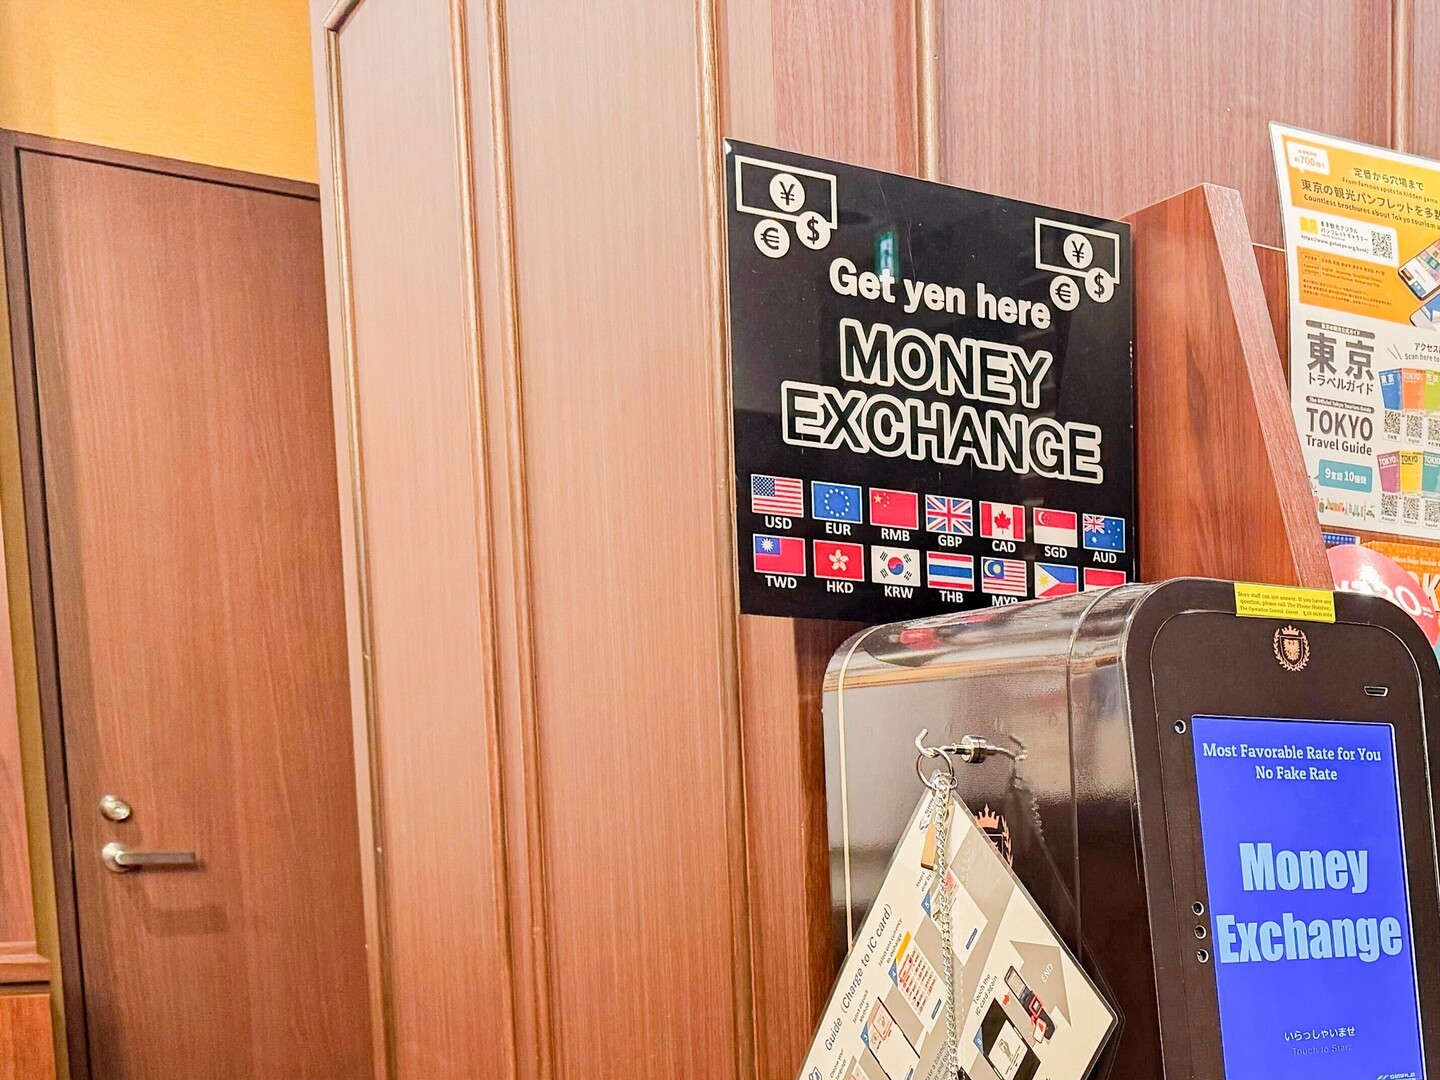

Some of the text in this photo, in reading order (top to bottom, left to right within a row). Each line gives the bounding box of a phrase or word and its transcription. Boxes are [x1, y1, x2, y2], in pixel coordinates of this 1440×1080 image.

[1303, 193, 1336, 207] Countless
[1337, 200, 1370, 214] brochures
[1372, 208, 1390, 218] about
[1391, 212, 1410, 224] Tokyo
[1411, 217, 1435, 229] tourism
[829, 257, 1052, 330] Get yen here
[839, 318, 1053, 408] MONEY
[1305, 330, 1374, 382] 東京
[1404, 352, 1418, 361] Scan
[1419, 353, 1431, 362] here
[1308, 372, 1373, 396] トラベルガイド
[781, 381, 1103, 484] EXCHANGE
[1306, 407, 1373, 441] TOKYO
[1305, 434, 1372, 456] Travel Guide
[1401, 453, 1418, 464] TOKYO
[765, 515, 1117, 564] USD EUR RMB GBP CAD SGD AUD
[765, 575, 964, 603] TWD HKD KRW THB
[1203, 743, 1382, 761] Most Favorable Rate for You
[1256, 766, 1337, 780] No Fake Rate
[1239, 843, 1368, 893] Money
[1216, 912, 1403, 964] Exchange
[972, 973, 990, 1004] Touch the
[1040, 963, 1053, 982] END
[824, 1017, 841, 1050] Guide
[860, 953, 869, 967] to
[866, 936, 877, 953] IC
[974, 975, 997, 1016] IC card again
[1284, 1027, 1355, 1042] いらっしゃいませ
